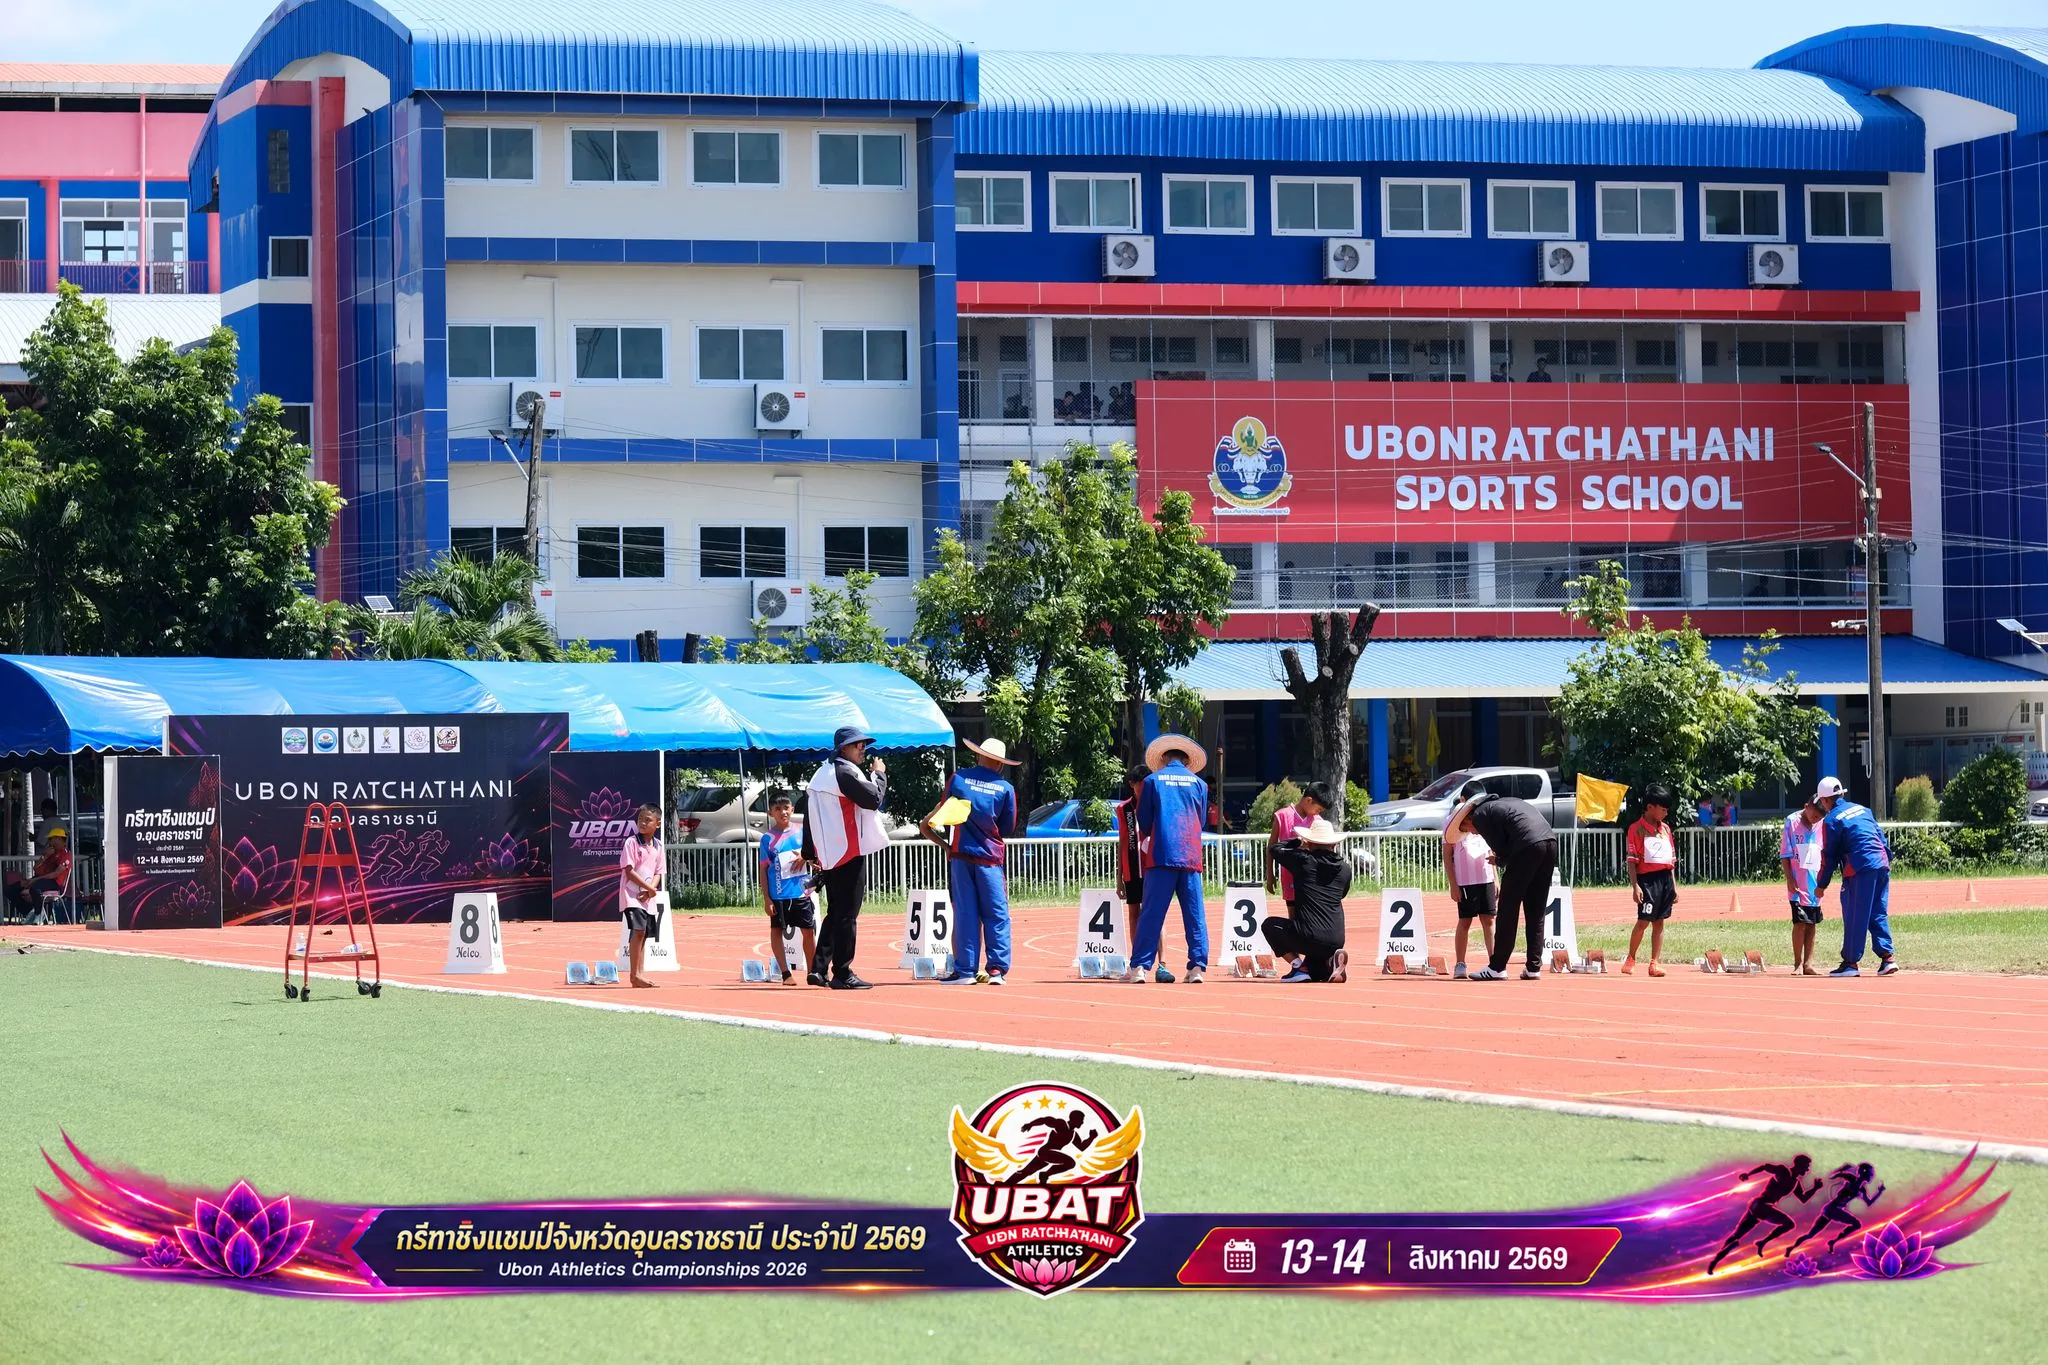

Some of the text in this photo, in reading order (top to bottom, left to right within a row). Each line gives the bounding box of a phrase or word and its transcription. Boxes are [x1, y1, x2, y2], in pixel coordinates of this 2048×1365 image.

[1344, 425, 1774, 462] UBONRATCHATHANI
[1395, 475, 1743, 511] SPORTS SCHOOL
[235, 780, 512, 800] UBON RATCHATHANI
[136, 827, 203, 845] จ.อุบลราชธานี
[1651, 841, 1663, 859] 2
[187, 855, 205, 864] 2569
[460, 904, 480, 944] 8
[490, 905, 498, 944] 8
[909, 901, 922, 941] 5
[933, 901, 948, 941] 5
[1088, 901, 1114, 940] 4
[1233, 899, 1257, 938] 3
[1390, 900, 1414, 938] 2
[1545, 898, 1561, 936] 1
[456, 946, 480, 959] Nelco
[1085, 942, 1115, 954] Nelco
[1386, 941, 1415, 953] Nelco
